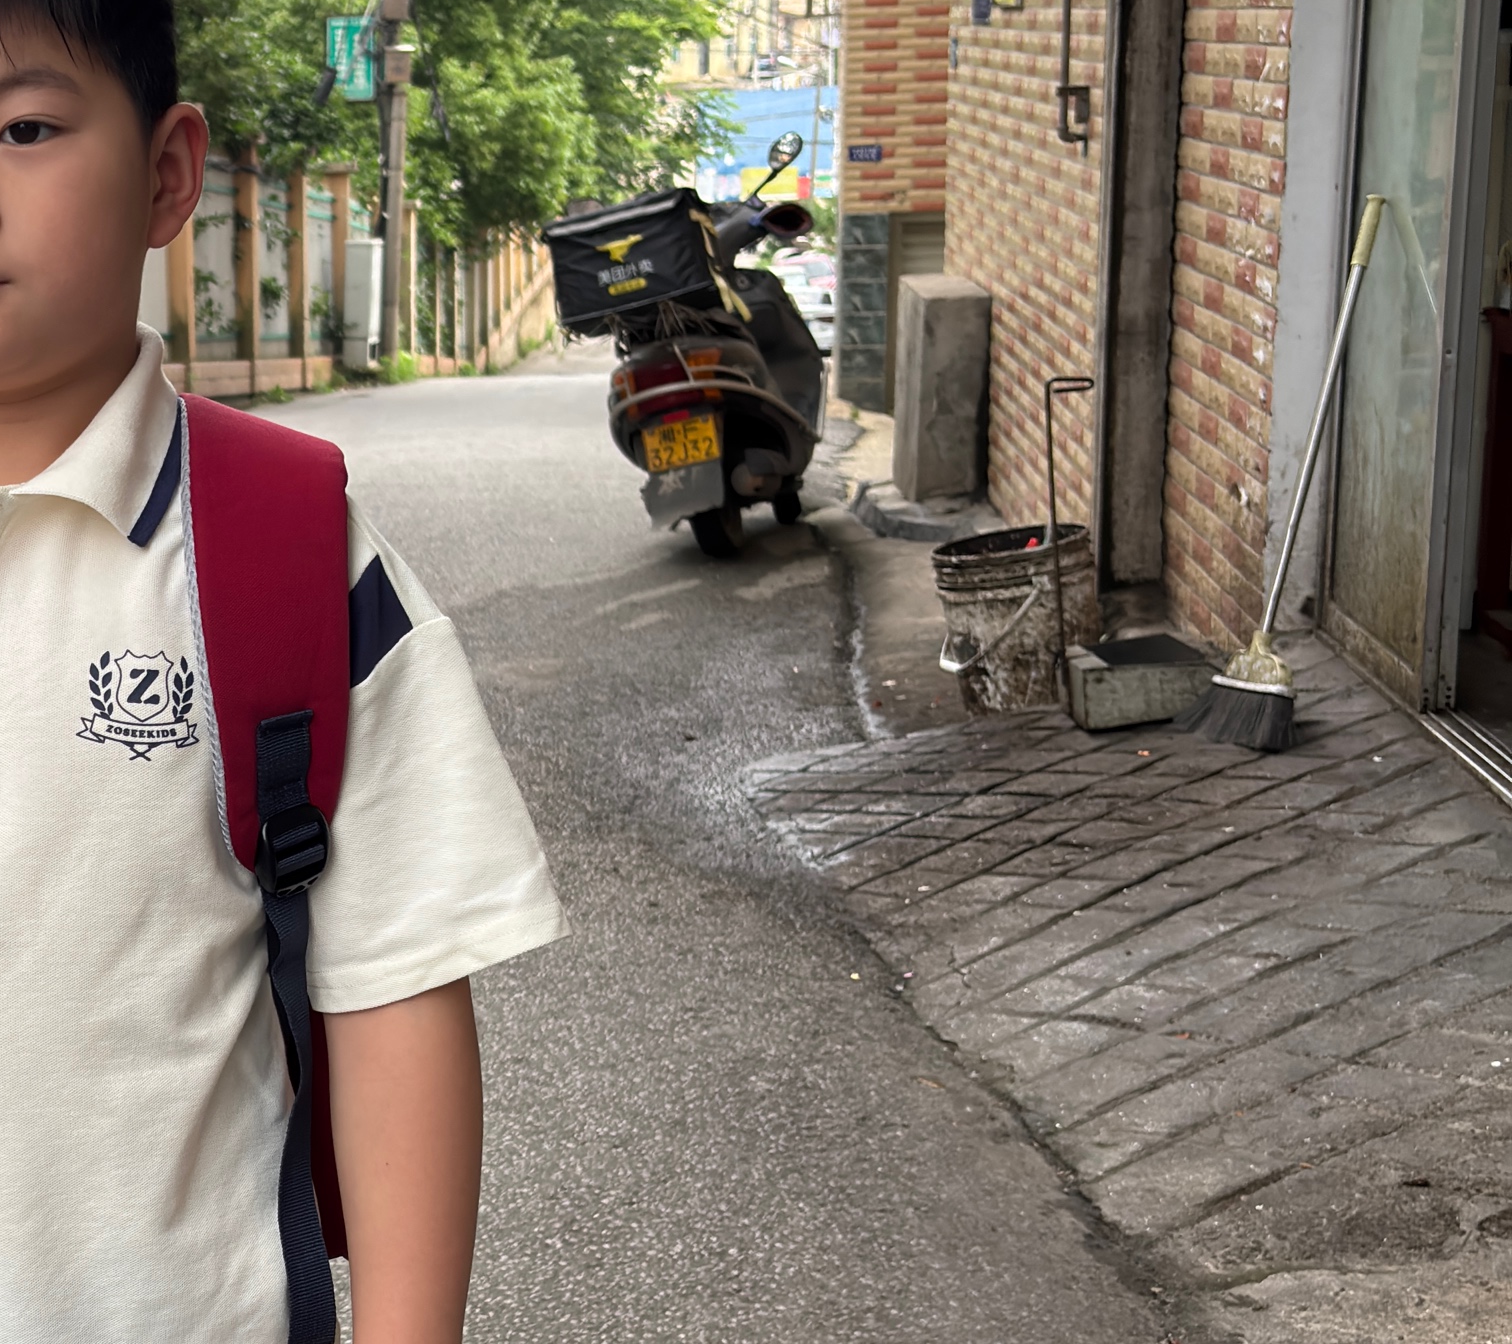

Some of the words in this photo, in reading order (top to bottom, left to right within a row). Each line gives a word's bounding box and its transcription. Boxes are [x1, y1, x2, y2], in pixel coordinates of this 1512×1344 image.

[597, 259, 654, 287] 美团外卖
[650, 437, 715, 468] 32J32
[126, 668, 161, 705] Z
[105, 724, 177, 739] ZOSEEKIDS
